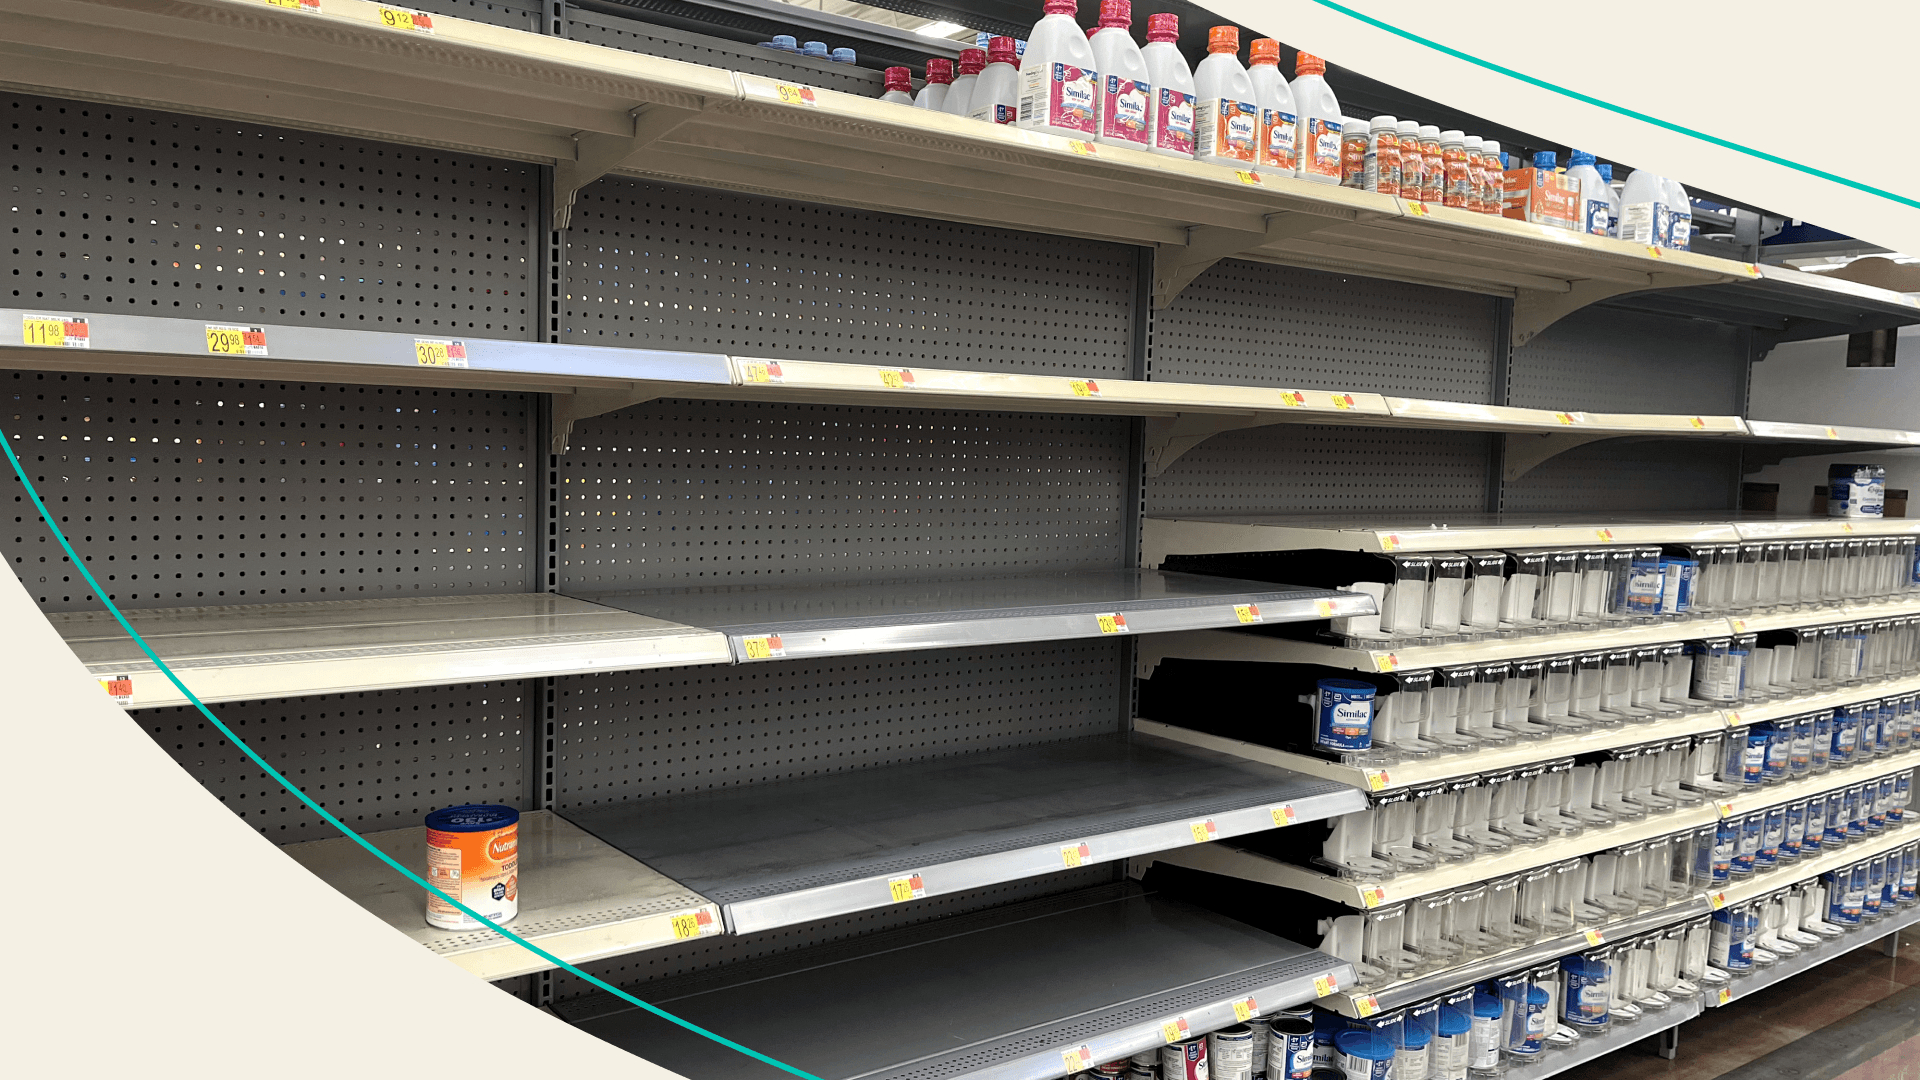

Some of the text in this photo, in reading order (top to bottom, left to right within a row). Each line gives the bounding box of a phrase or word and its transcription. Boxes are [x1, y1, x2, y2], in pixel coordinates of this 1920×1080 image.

[1066, 86, 1091, 101] Similac
[1170, 110, 1191, 124] Similac
[1635, 580, 1661, 590] Similc
[1336, 707, 1368, 719] Similac
[1384, 912, 1397, 920] SLIDE
[1384, 1018, 1397, 1026] SLIDE
